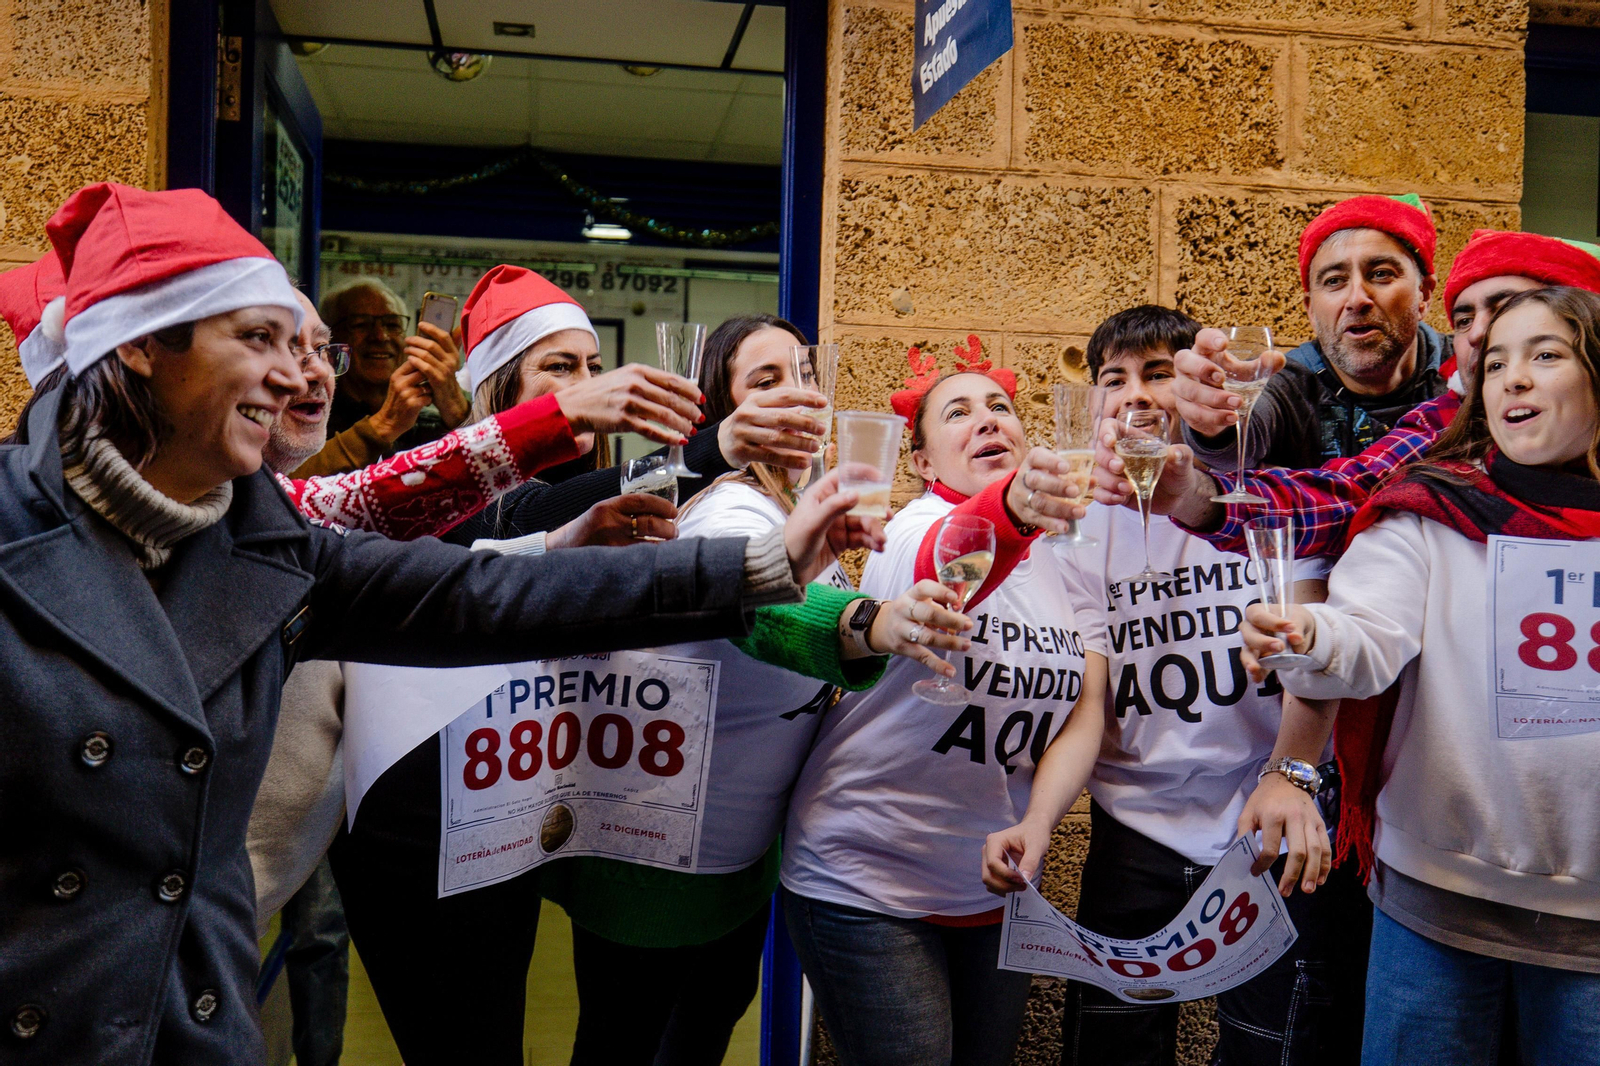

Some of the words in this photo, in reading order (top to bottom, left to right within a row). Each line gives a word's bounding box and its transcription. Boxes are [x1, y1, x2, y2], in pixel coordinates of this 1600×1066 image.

[920, 35, 958, 94] Estado
[602, 272, 677, 293] 87092
[1129, 558, 1269, 605] PREMIO
[1546, 568, 1585, 605] 1er
[1002, 621, 1085, 659] PREMIO
[1108, 598, 1261, 654] VENDID
[1518, 612, 1600, 674] 8
[510, 670, 670, 714] PREMIO
[964, 656, 1085, 702] VENDID
[463, 711, 686, 790] 88008
[931, 704, 1054, 775] AQU
[593, 791, 627, 800] TENERNOS
[456, 847, 492, 864] LOTERÍA
[500, 836, 534, 853] NAVIDAD
[600, 823, 612, 831] 22
[614, 824, 667, 840] DICIEMBRE
[1020, 942, 1063, 955] LOTERÍA
